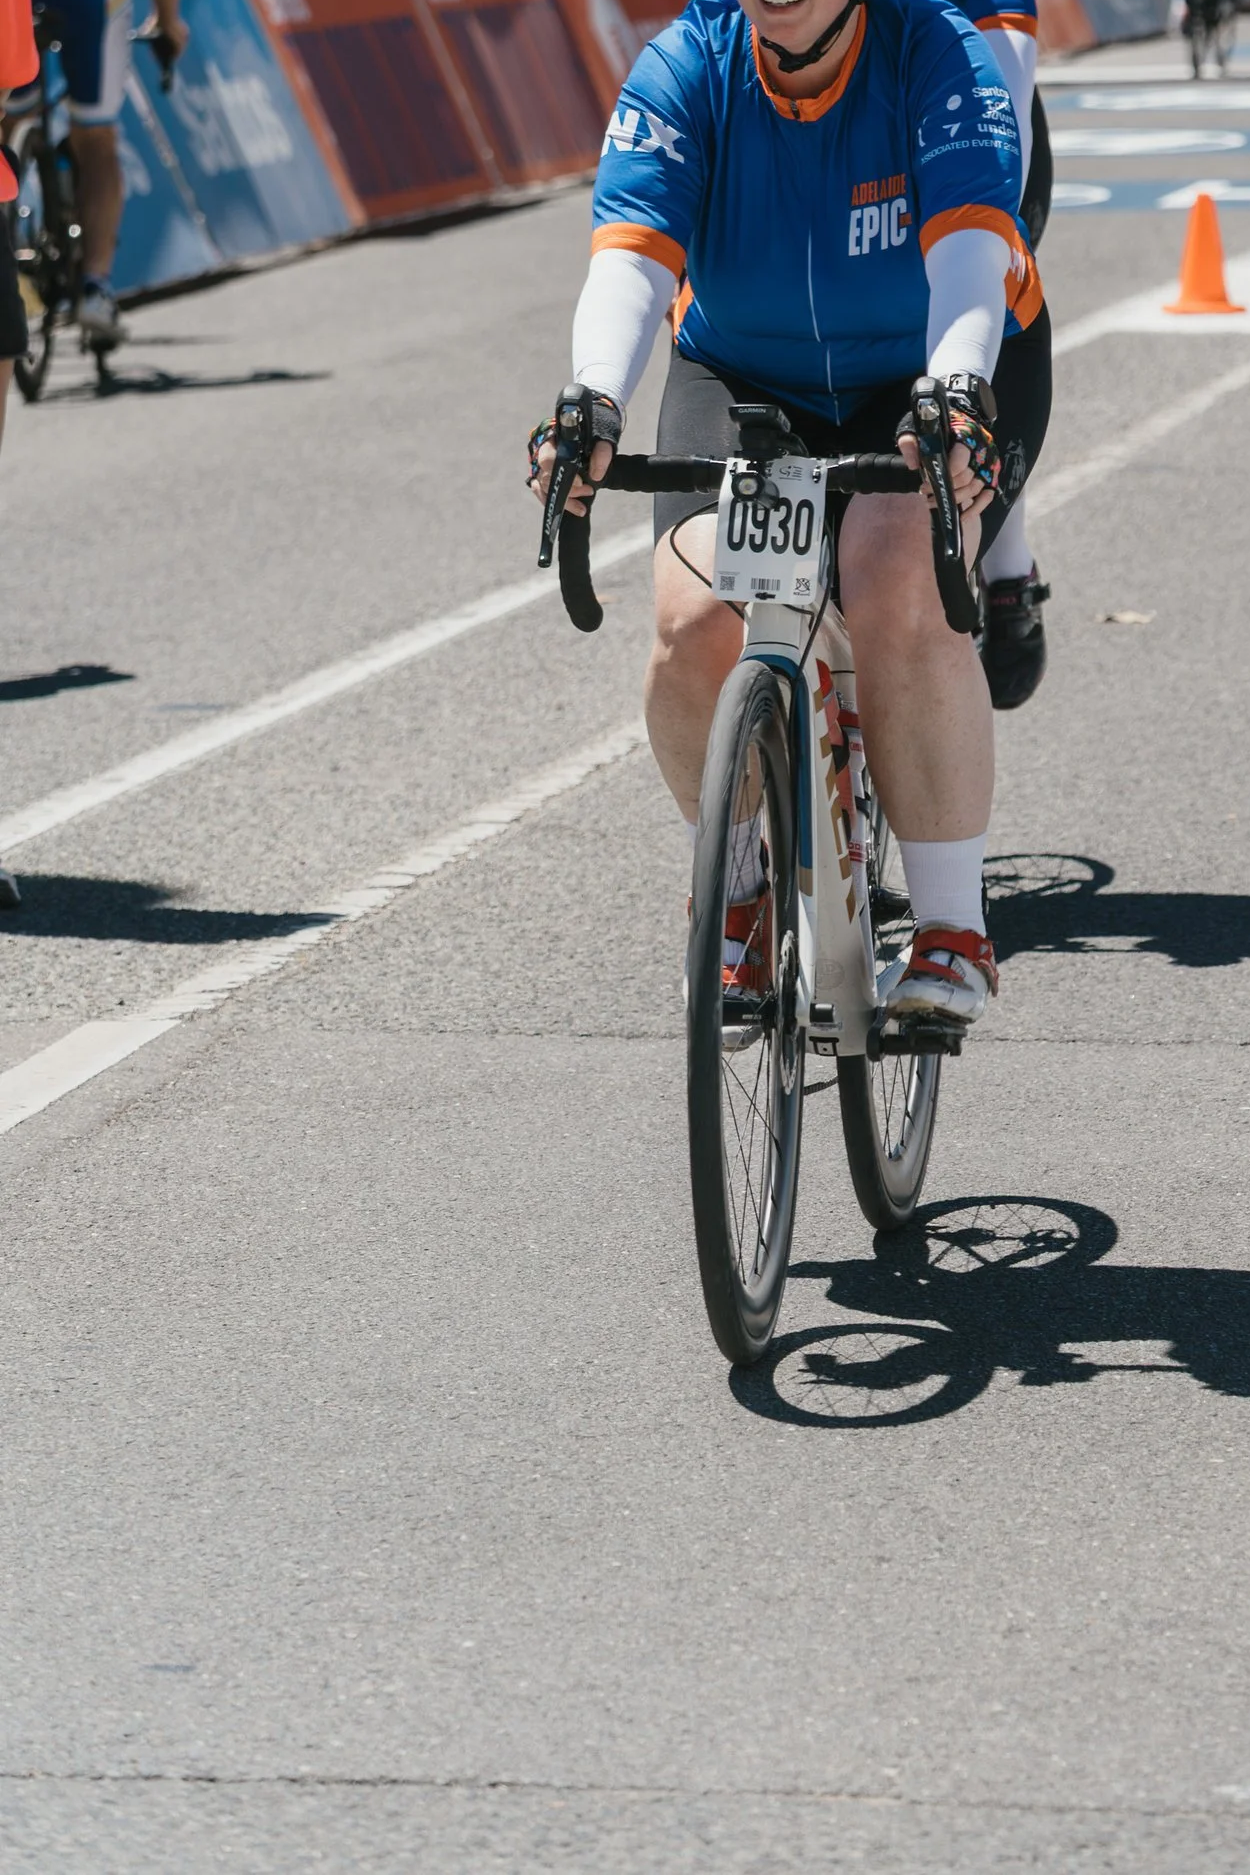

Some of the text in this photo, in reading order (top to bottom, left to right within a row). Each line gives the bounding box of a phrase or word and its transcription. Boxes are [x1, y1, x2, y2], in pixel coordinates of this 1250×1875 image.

[971, 138, 1003, 150] EVENT
[977, 123, 1018, 141] under
[851, 173, 907, 206] ADELAIDE
[848, 197, 908, 256] EPIC
[931, 460, 954, 530] ULTEGRA
[727, 496, 815, 556] 0930
